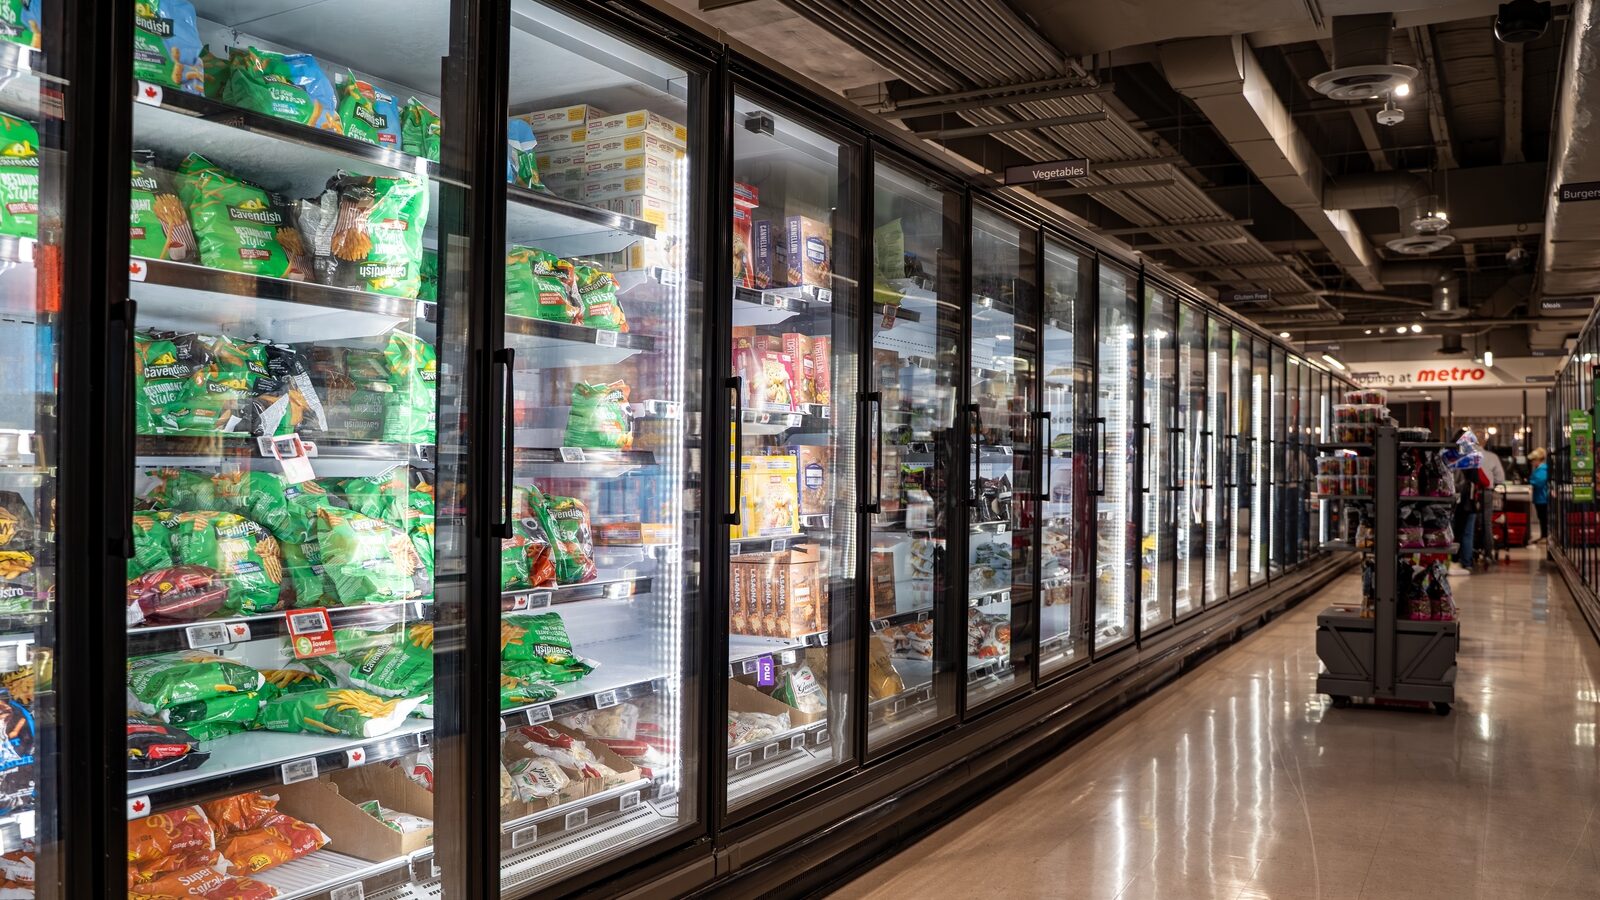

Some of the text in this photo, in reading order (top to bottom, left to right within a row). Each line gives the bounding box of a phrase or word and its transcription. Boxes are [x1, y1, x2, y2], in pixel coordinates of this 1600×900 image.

[1032, 166, 1084, 180] Vegetables
[1563, 190, 1600, 200] Burgers
[230, 208, 282, 222] Cavendish
[240, 232, 266, 248] Style
[144, 365, 190, 378] Cavendish
[1399, 374, 1411, 382] at
[1417, 367, 1485, 382] metro
[149, 392, 176, 406] Style
[178, 868, 213, 886] Super
